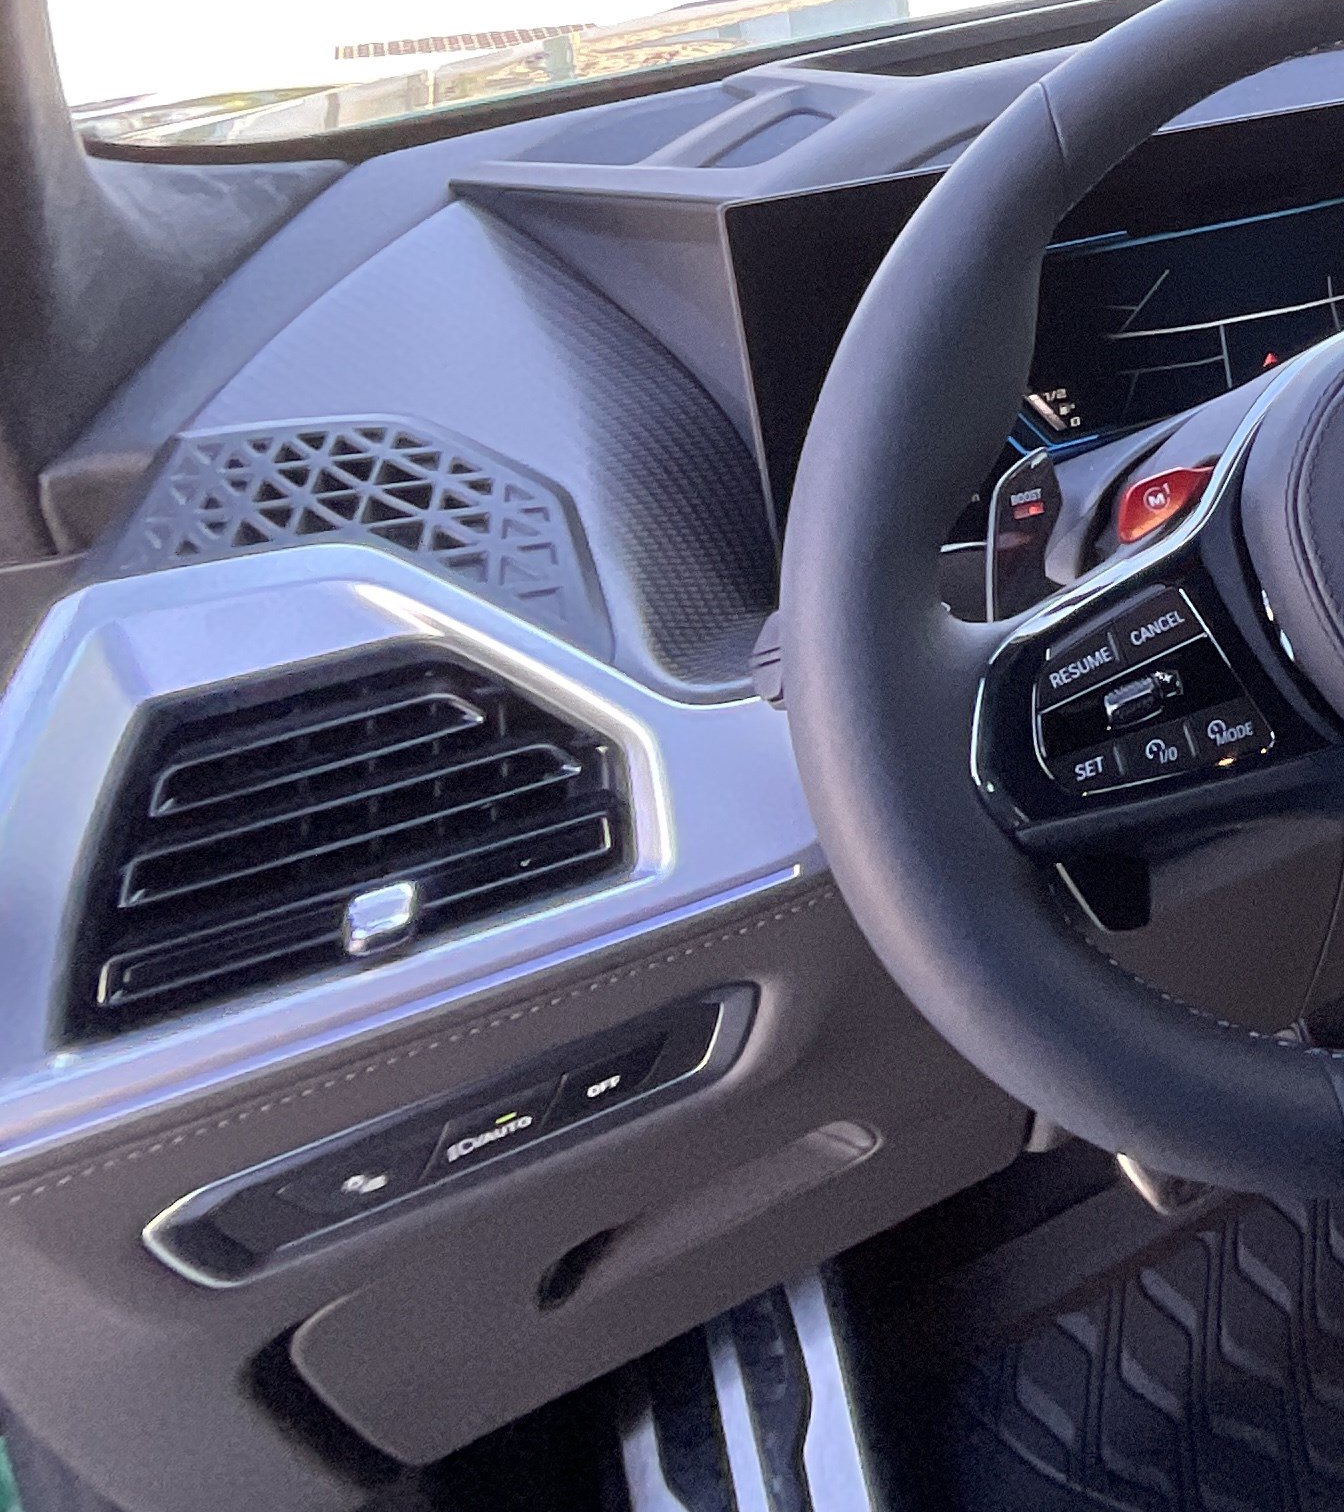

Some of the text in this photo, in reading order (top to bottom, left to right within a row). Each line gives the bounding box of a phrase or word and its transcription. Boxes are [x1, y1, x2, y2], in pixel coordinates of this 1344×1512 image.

[1130, 610, 1185, 646] CANCEL
[1049, 646, 1113, 688] RESUME
[1215, 721, 1254, 747] MODE
[1159, 745, 1178, 764] I/O
[1074, 756, 1104, 782] SET
